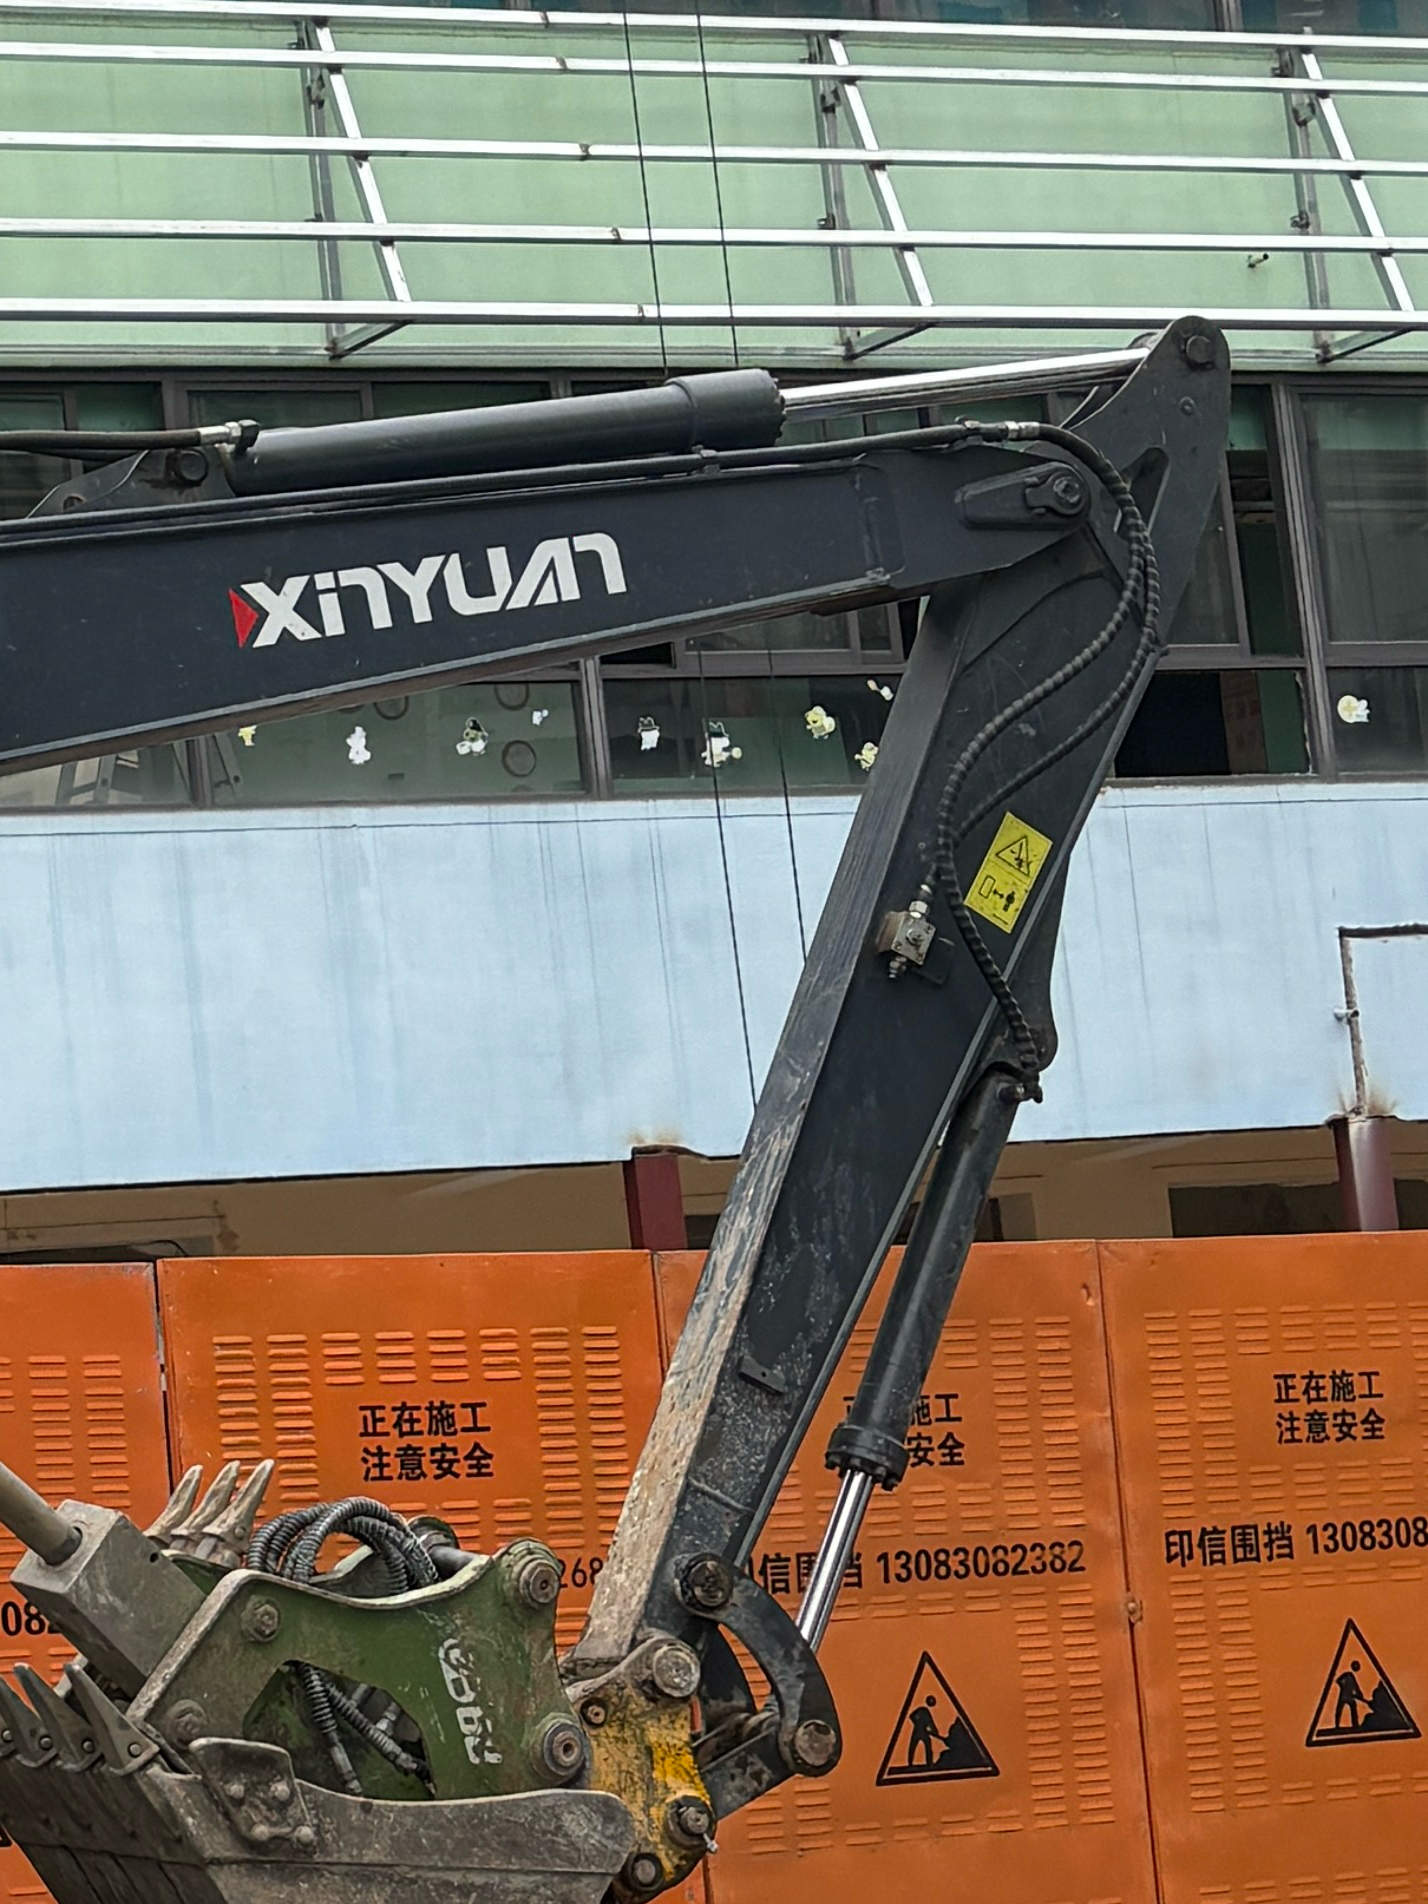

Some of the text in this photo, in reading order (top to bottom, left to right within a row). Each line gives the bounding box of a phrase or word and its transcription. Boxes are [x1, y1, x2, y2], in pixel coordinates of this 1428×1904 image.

[1273, 1369, 1384, 1404] 正在施工
[358, 1399, 492, 1438] 正在施工
[1276, 1407, 1385, 1444] 注意安全
[360, 1441, 494, 1482] 注意安全
[876, 1540, 1086, 1584] 13083082382
[1164, 1516, 1428, 1568] 印信围挡 1308308
